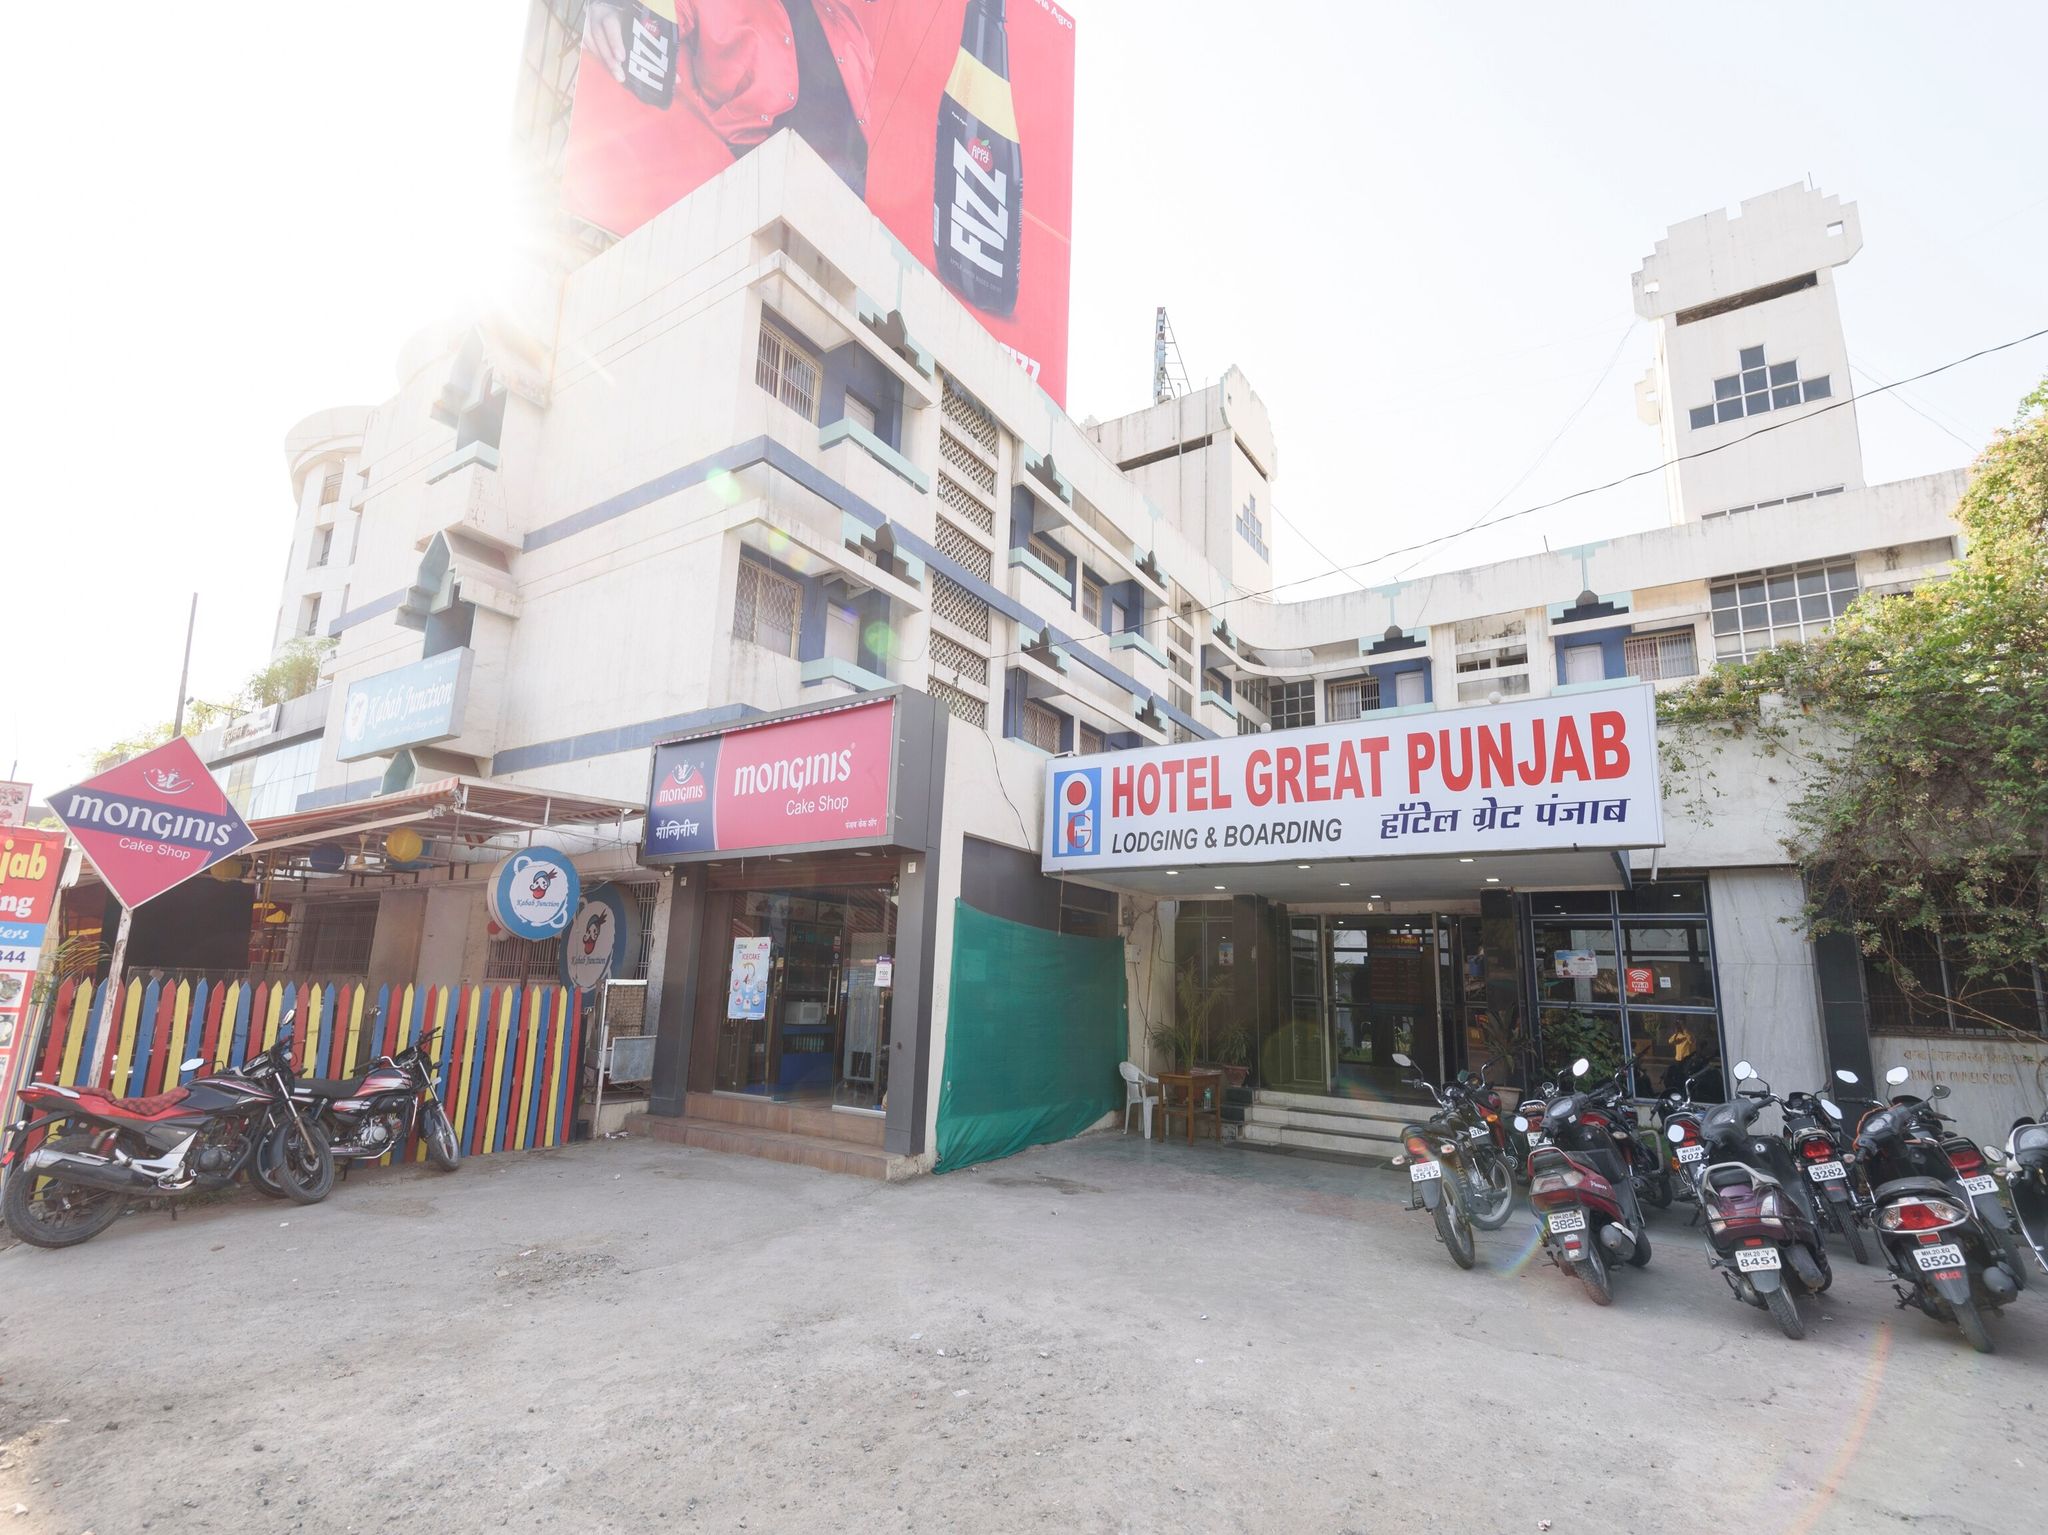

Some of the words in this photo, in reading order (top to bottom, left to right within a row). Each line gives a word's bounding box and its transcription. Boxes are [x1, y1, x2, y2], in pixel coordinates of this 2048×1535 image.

[628, 17, 669, 92] FIZZ
[950, 137, 1009, 278] FIZZ
[1113, 757, 1232, 817] HOTEL
[1246, 737, 1389, 806] GREAT
[1408, 711, 1631, 794] PUNJAB
[786, 799, 815, 816] Cake
[818, 795, 849, 813] Shop
[1380, 801, 1462, 840] हॉटेल
[1472, 796, 1524, 832] ग्रेट
[1536, 793, 1632, 827] पंजाब
[1112, 828, 1198, 854] LODGING
[1205, 827, 1218, 849] &
[1224, 818, 1343, 848] BOARDING
[119, 837, 154, 855] Cake
[157, 843, 191, 861] Shop
[0, 893, 35, 918] ng
[1681, 1152, 1700, 1162] 802
[1413, 1170, 1440, 1181] 5512
[1812, 1168, 1844, 1180] 3282
[1968, 1180, 1993, 1192] 657
[1551, 1217, 1584, 1231] 3825
[1740, 1255, 1777, 1268] 8451
[1920, 1253, 1961, 1269] 8520
[1935, 1270, 1962, 1281] POLICE
